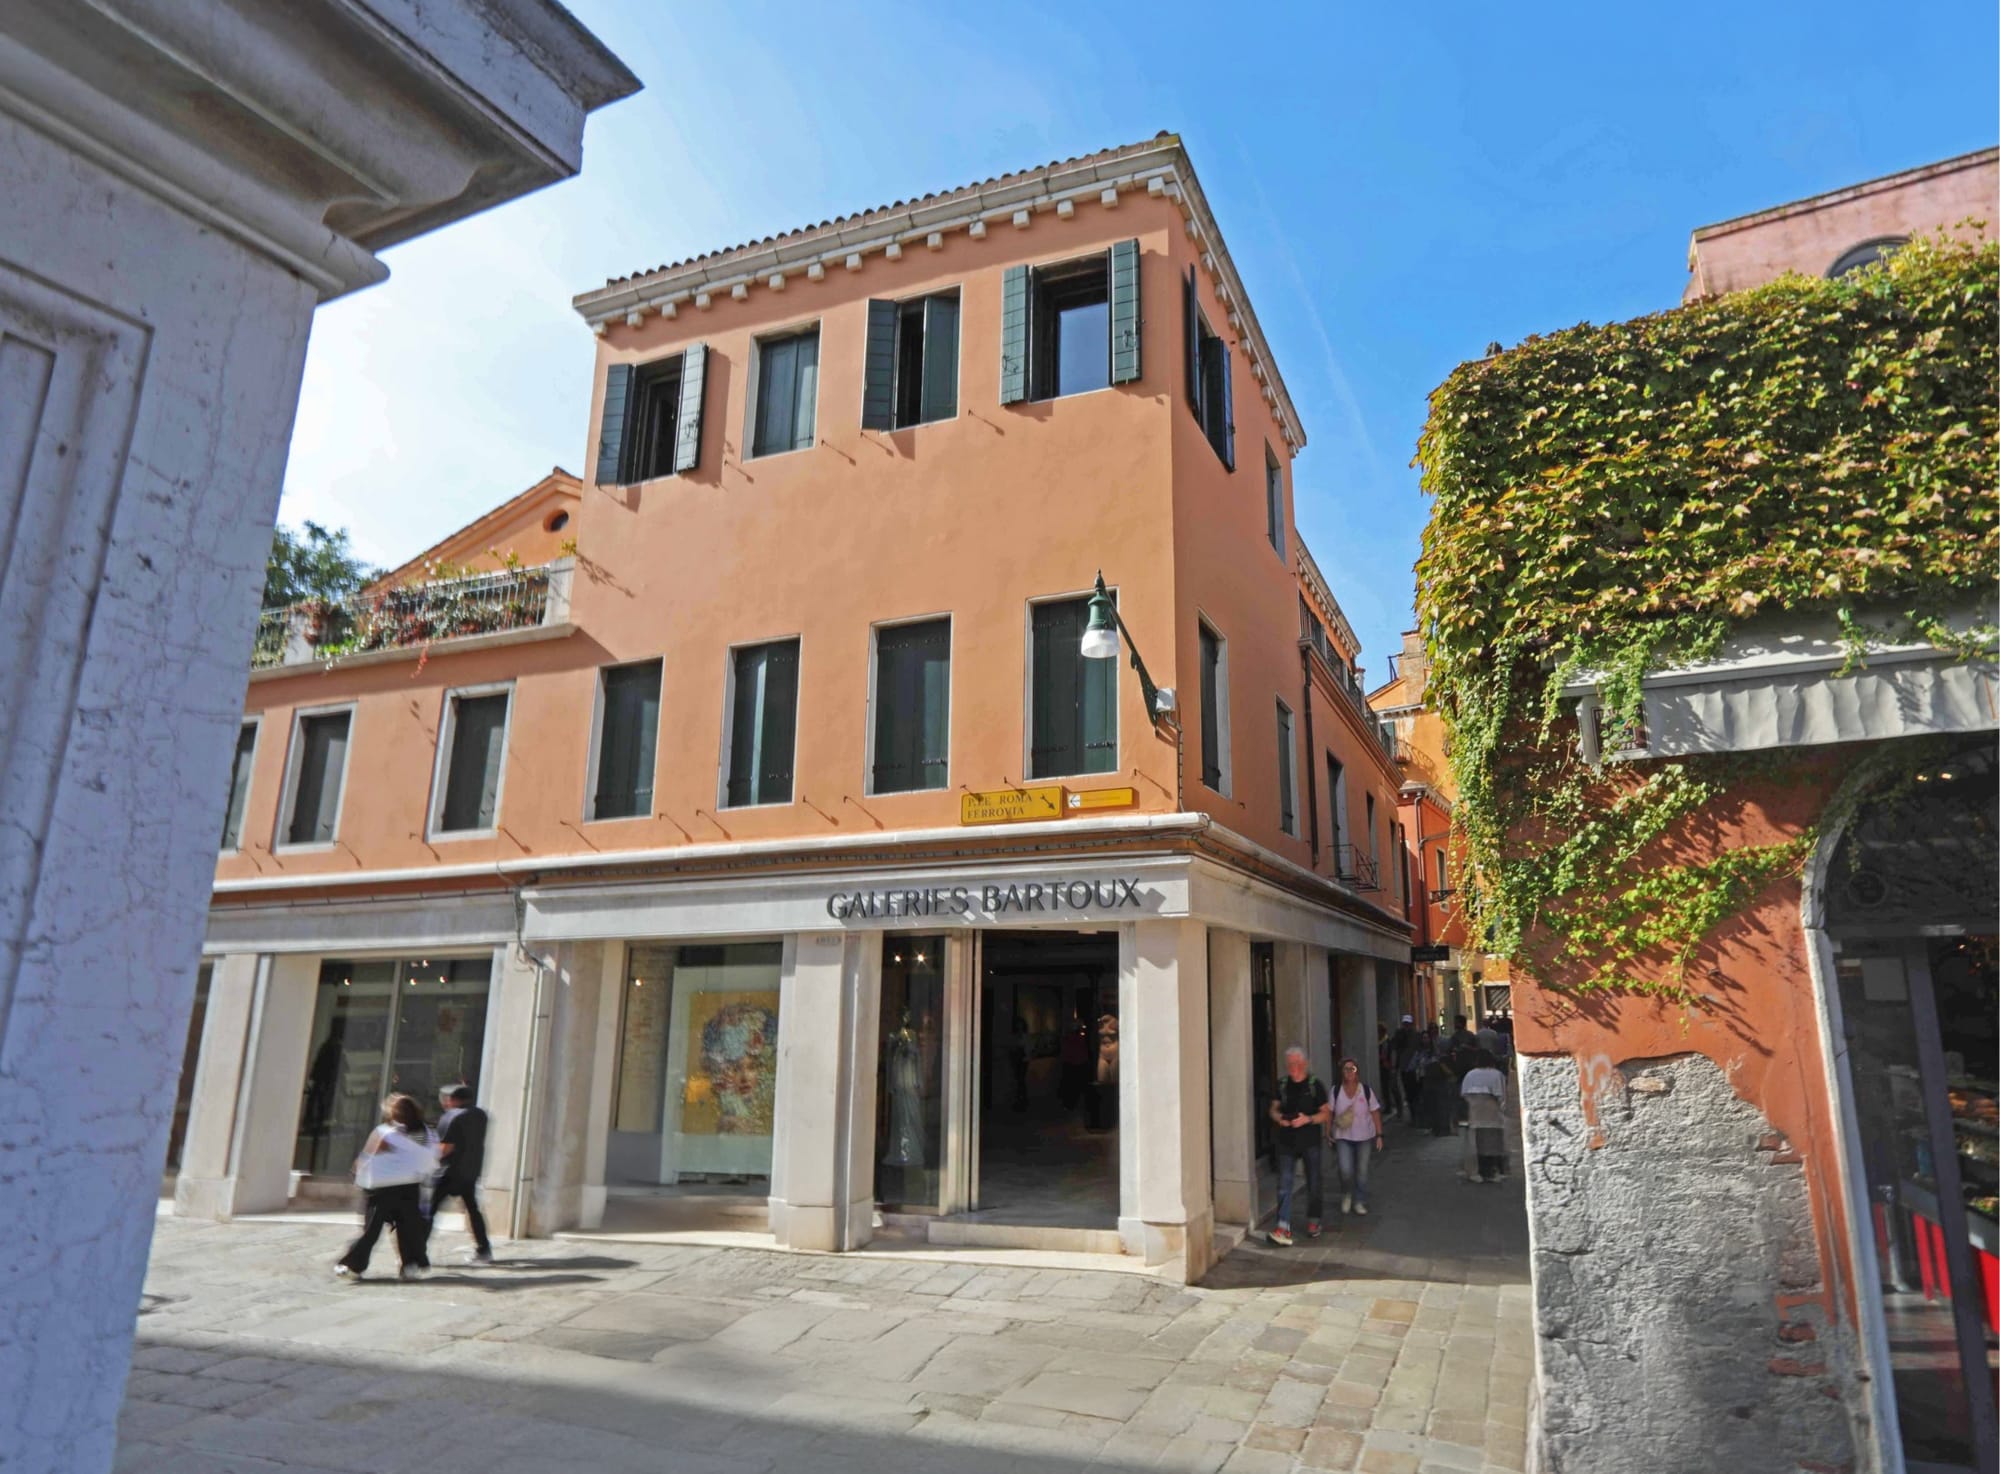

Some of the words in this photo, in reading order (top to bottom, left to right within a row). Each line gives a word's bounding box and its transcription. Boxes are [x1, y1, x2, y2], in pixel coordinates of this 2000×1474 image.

[999, 792, 1033, 805] ROMA
[967, 806, 1025, 819] FERROVIA
[826, 885, 970, 920] GALERIES
[981, 878, 1141, 913] BARTOUX
